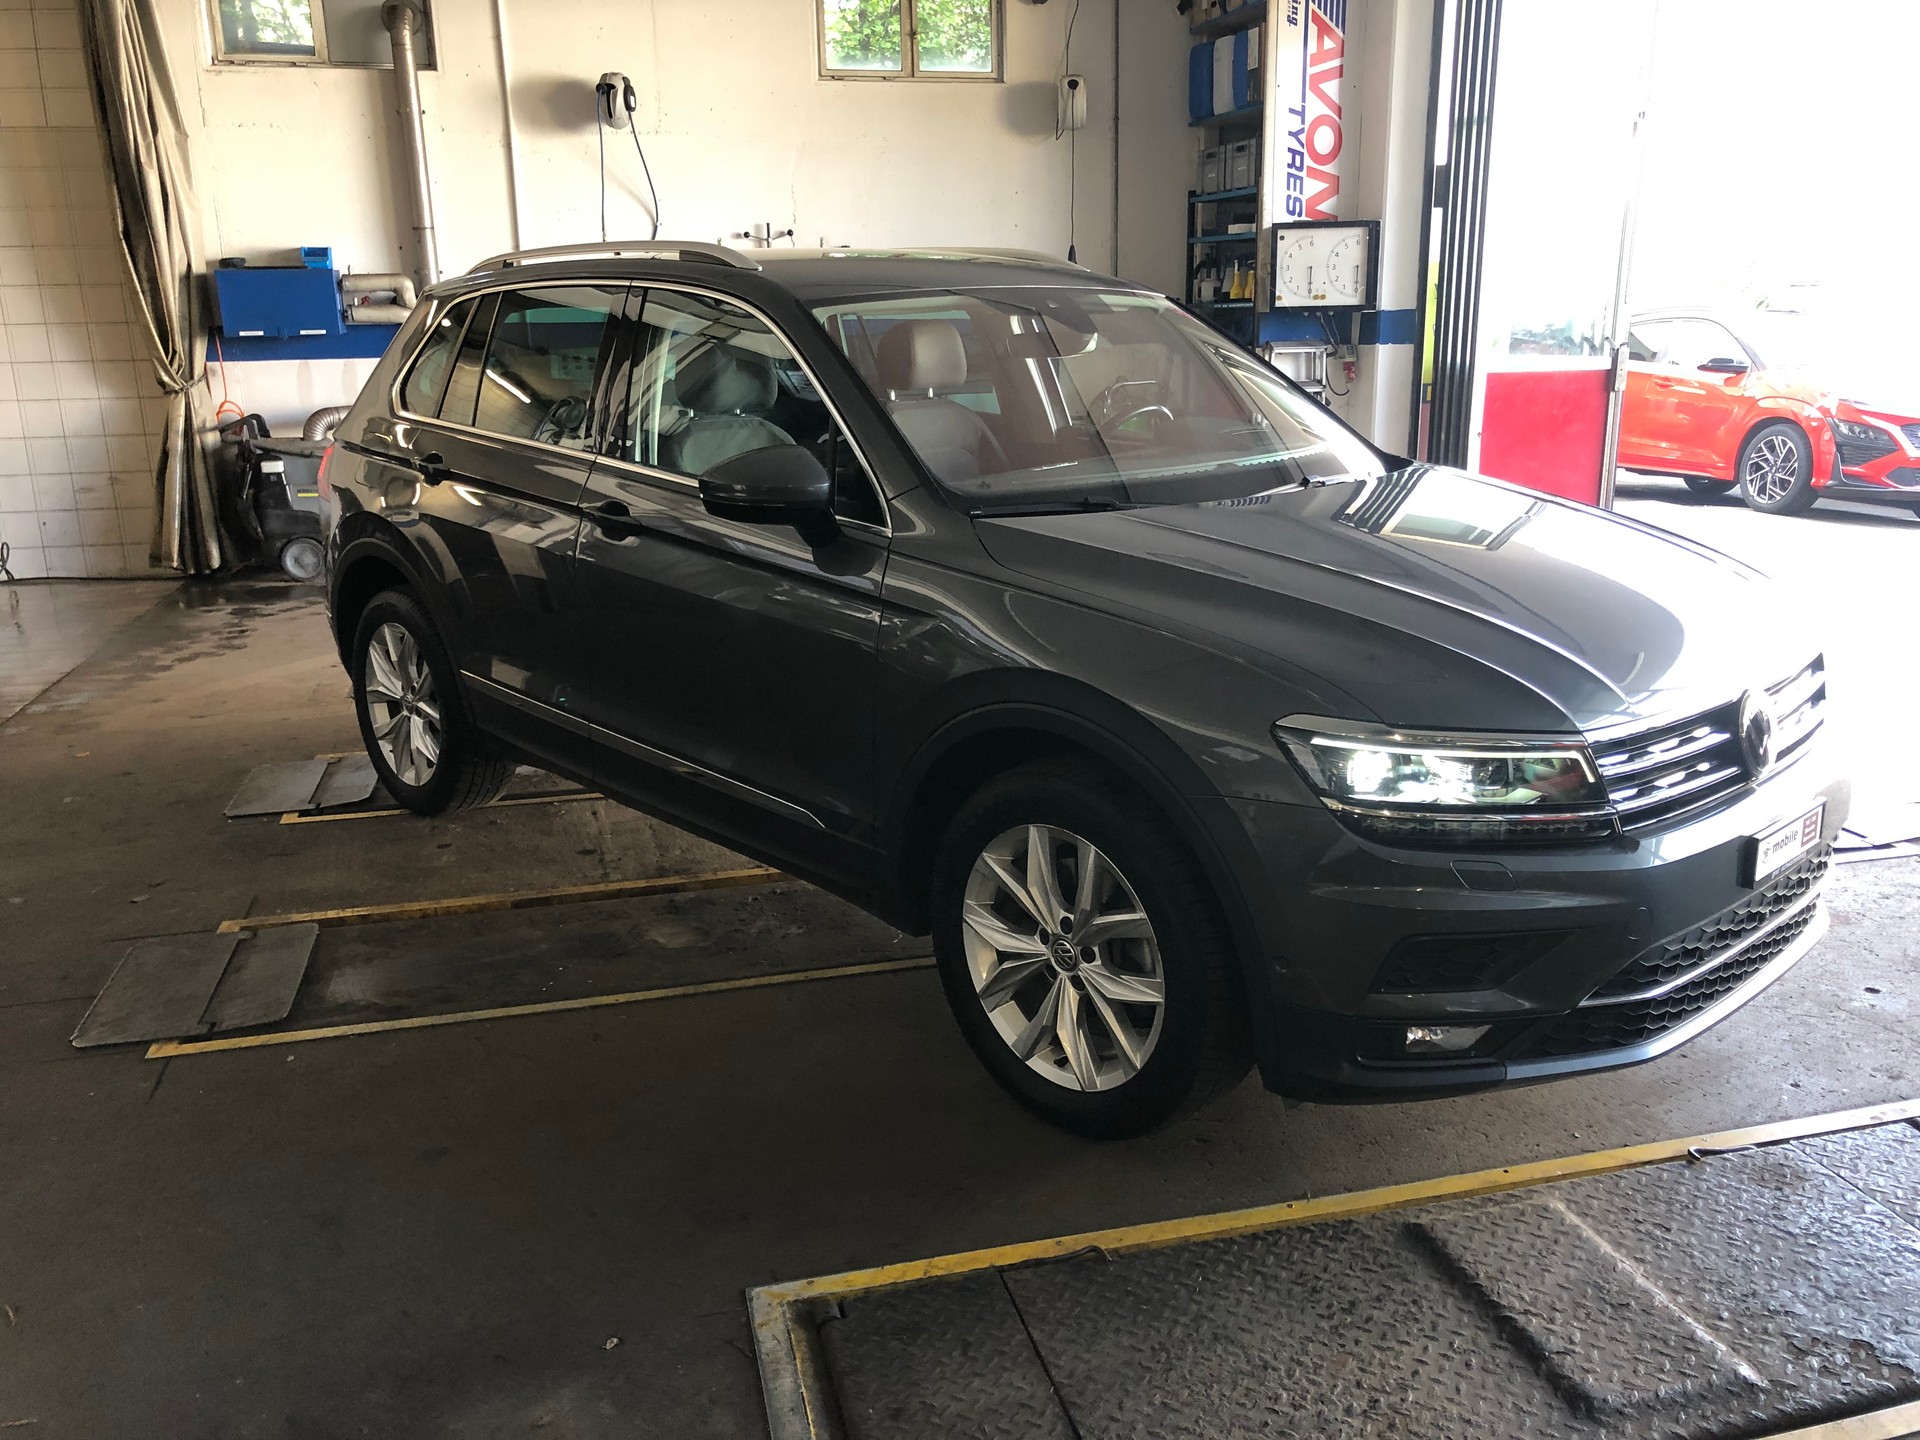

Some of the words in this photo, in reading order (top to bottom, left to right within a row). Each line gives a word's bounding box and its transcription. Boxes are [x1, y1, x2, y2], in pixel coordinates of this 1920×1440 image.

[1286, 104, 1306, 218] TYRES
[1304, 8, 1345, 222] AVON
[1772, 830, 1799, 854] mobile
